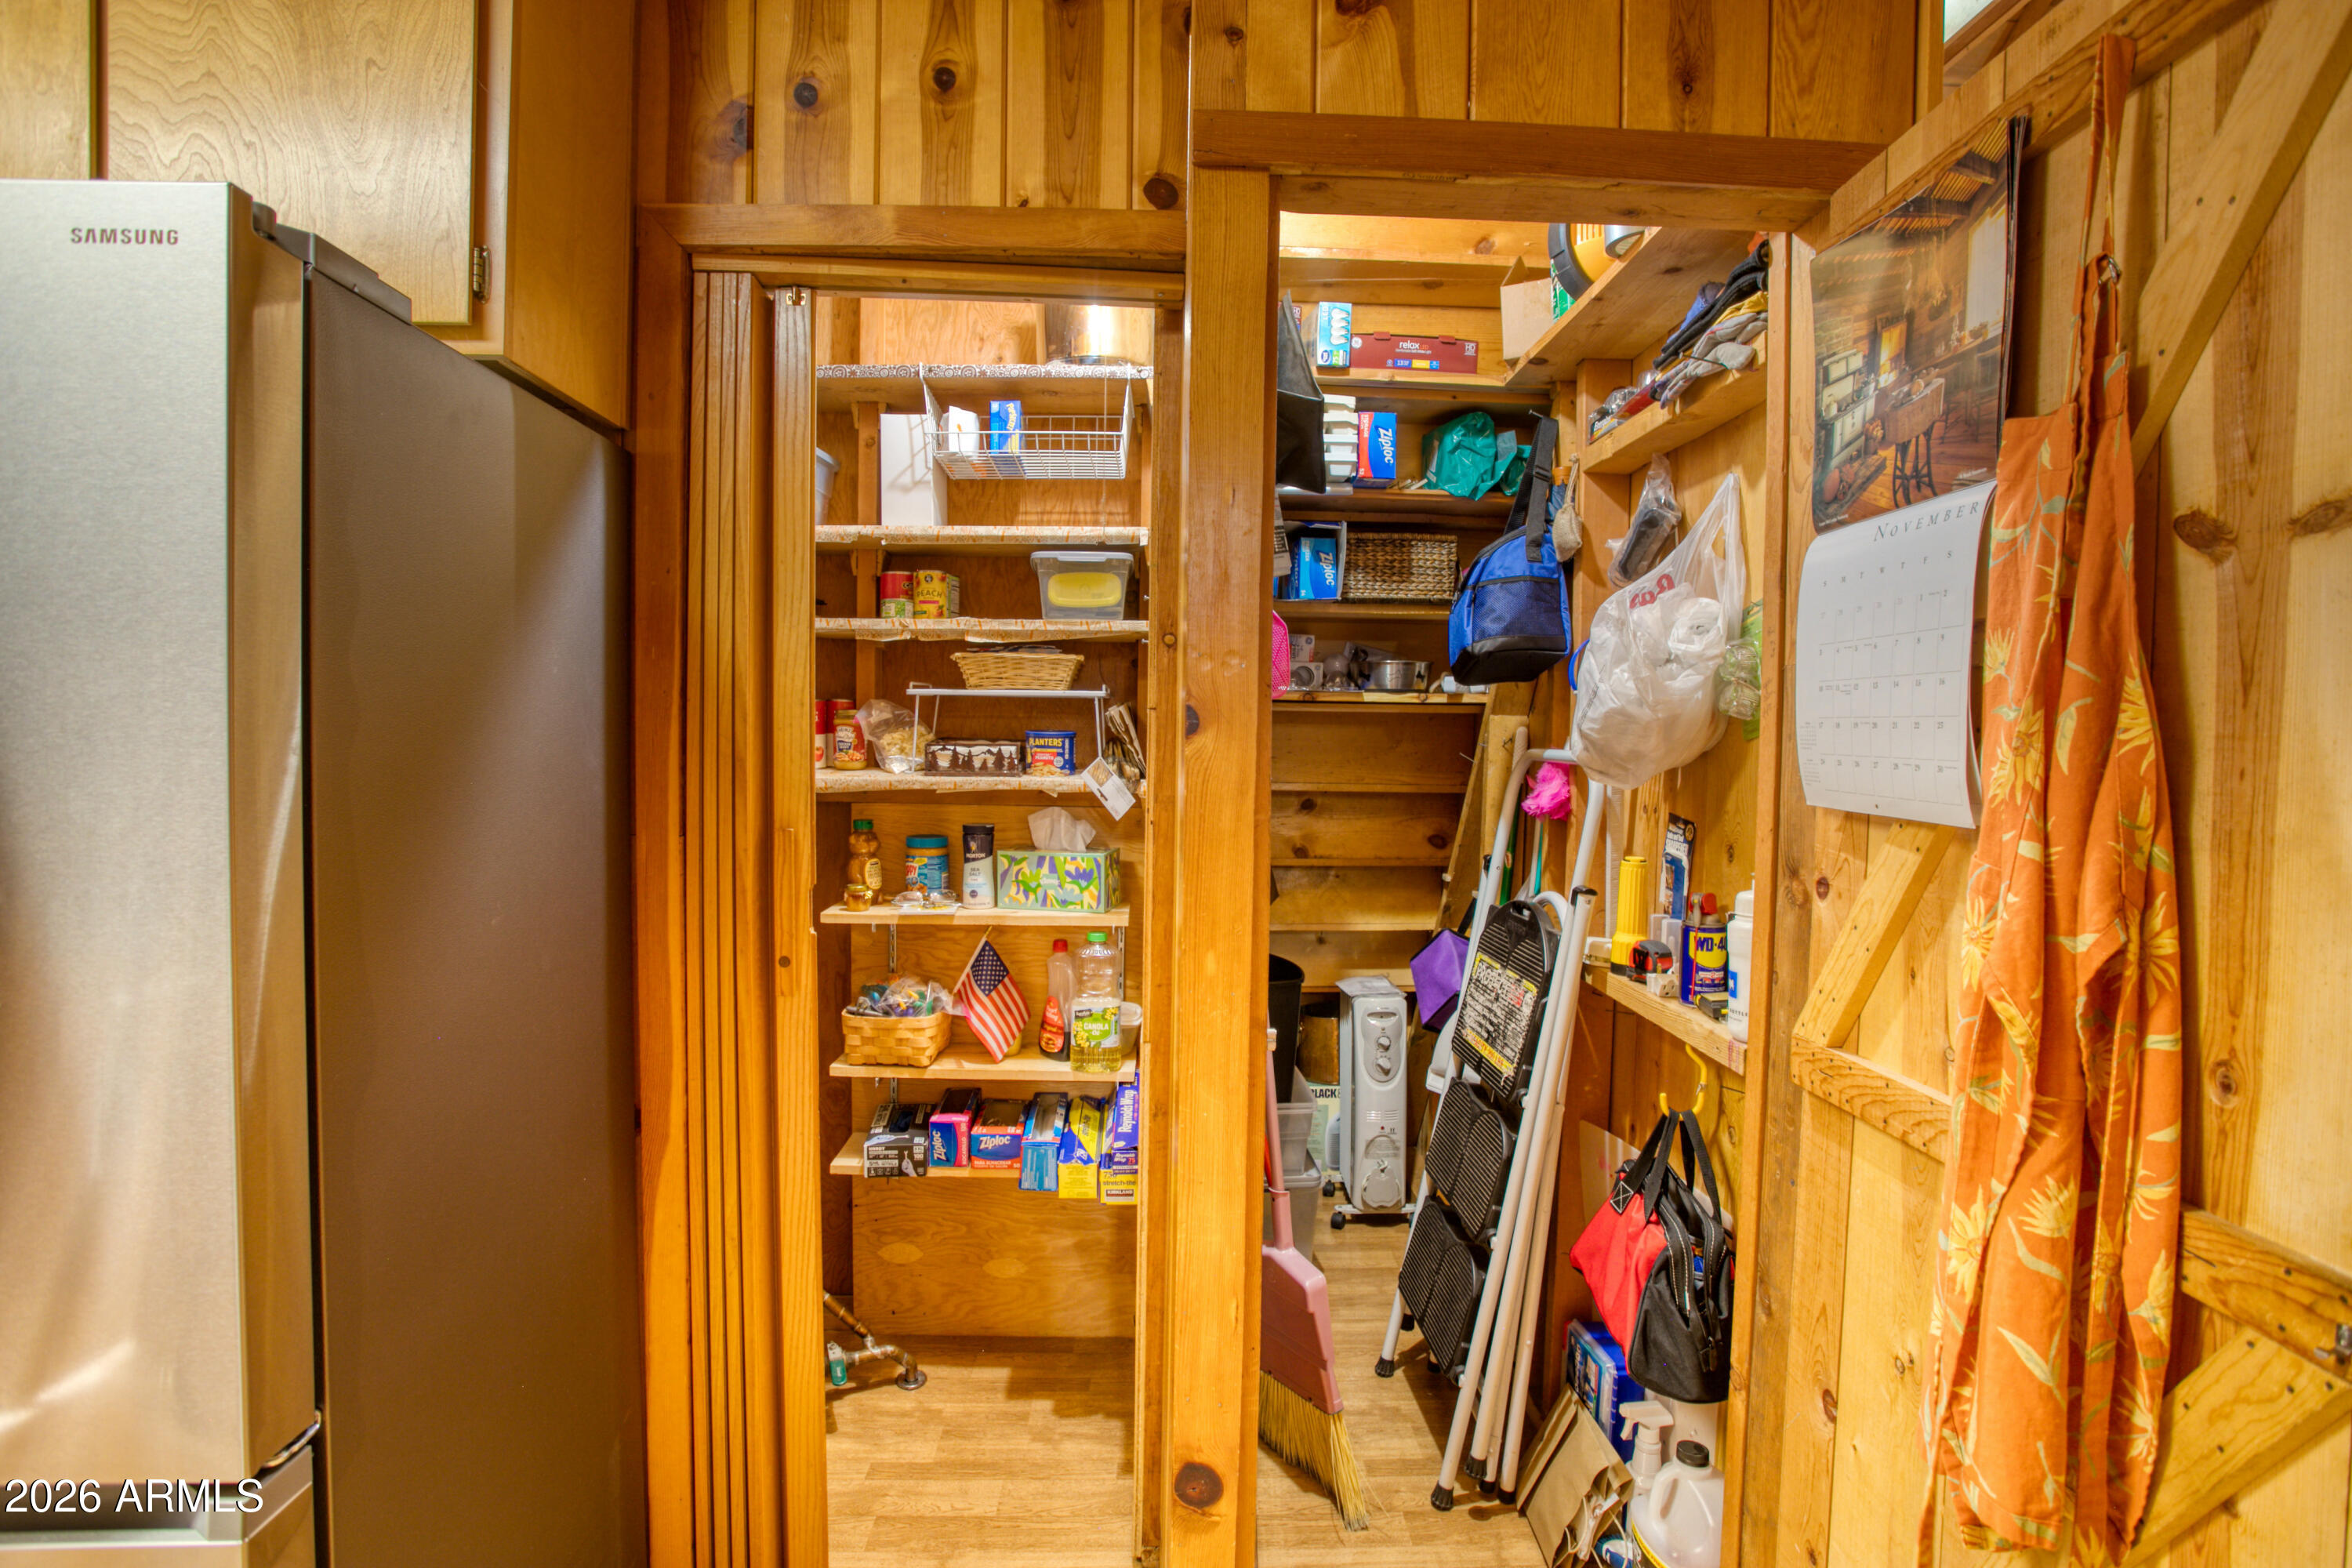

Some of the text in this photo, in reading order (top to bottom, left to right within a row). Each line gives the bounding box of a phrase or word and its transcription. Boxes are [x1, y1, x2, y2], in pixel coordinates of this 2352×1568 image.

[71, 227, 179, 245] SAMSUNG
[1399, 340, 1420, 350] relax
[1378, 428, 1394, 464] Ziploc
[1873, 501, 1979, 542] NOVEMBER
[1319, 552, 1336, 586] Ziploc
[1029, 738, 1062, 747] PLANTERS
[1312, 1088, 1337, 1098] LACK
[1117, 1089, 1137, 1133] Reynolds Wrap
[932, 1130, 947, 1161] Ziploc
[978, 1134, 1011, 1150] Ziploc
